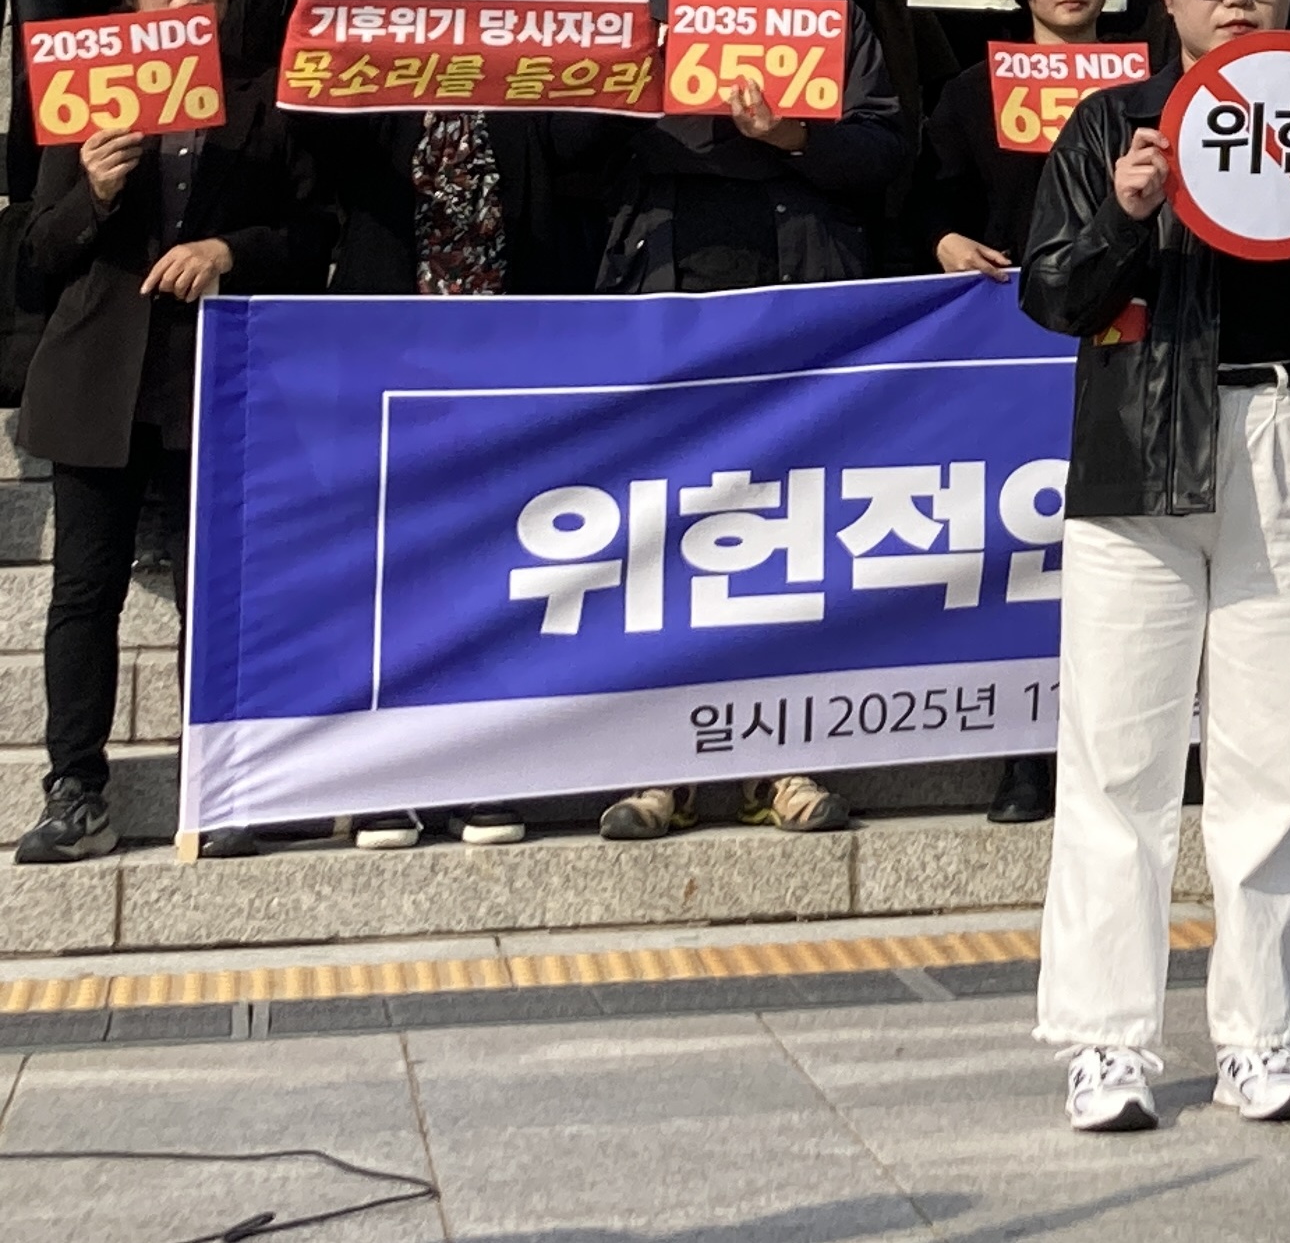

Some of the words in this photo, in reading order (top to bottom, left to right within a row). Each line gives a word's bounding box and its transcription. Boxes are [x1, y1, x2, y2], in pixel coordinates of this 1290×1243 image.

[31, 28, 122, 63] 2035
[131, 16, 213, 54] NDC
[309, 5, 467, 44] 기후위기
[479, 8, 633, 48] 당사자의
[673, 5, 756, 35] 2035
[765, 8, 842, 39] NDC
[285, 50, 485, 100] 목소리를
[505, 56, 653, 105] 들으라
[669, 43, 838, 110] 65%
[994, 52, 1068, 79] 2035
[1075, 52, 1146, 79] NDC
[39, 56, 219, 135] 65%
